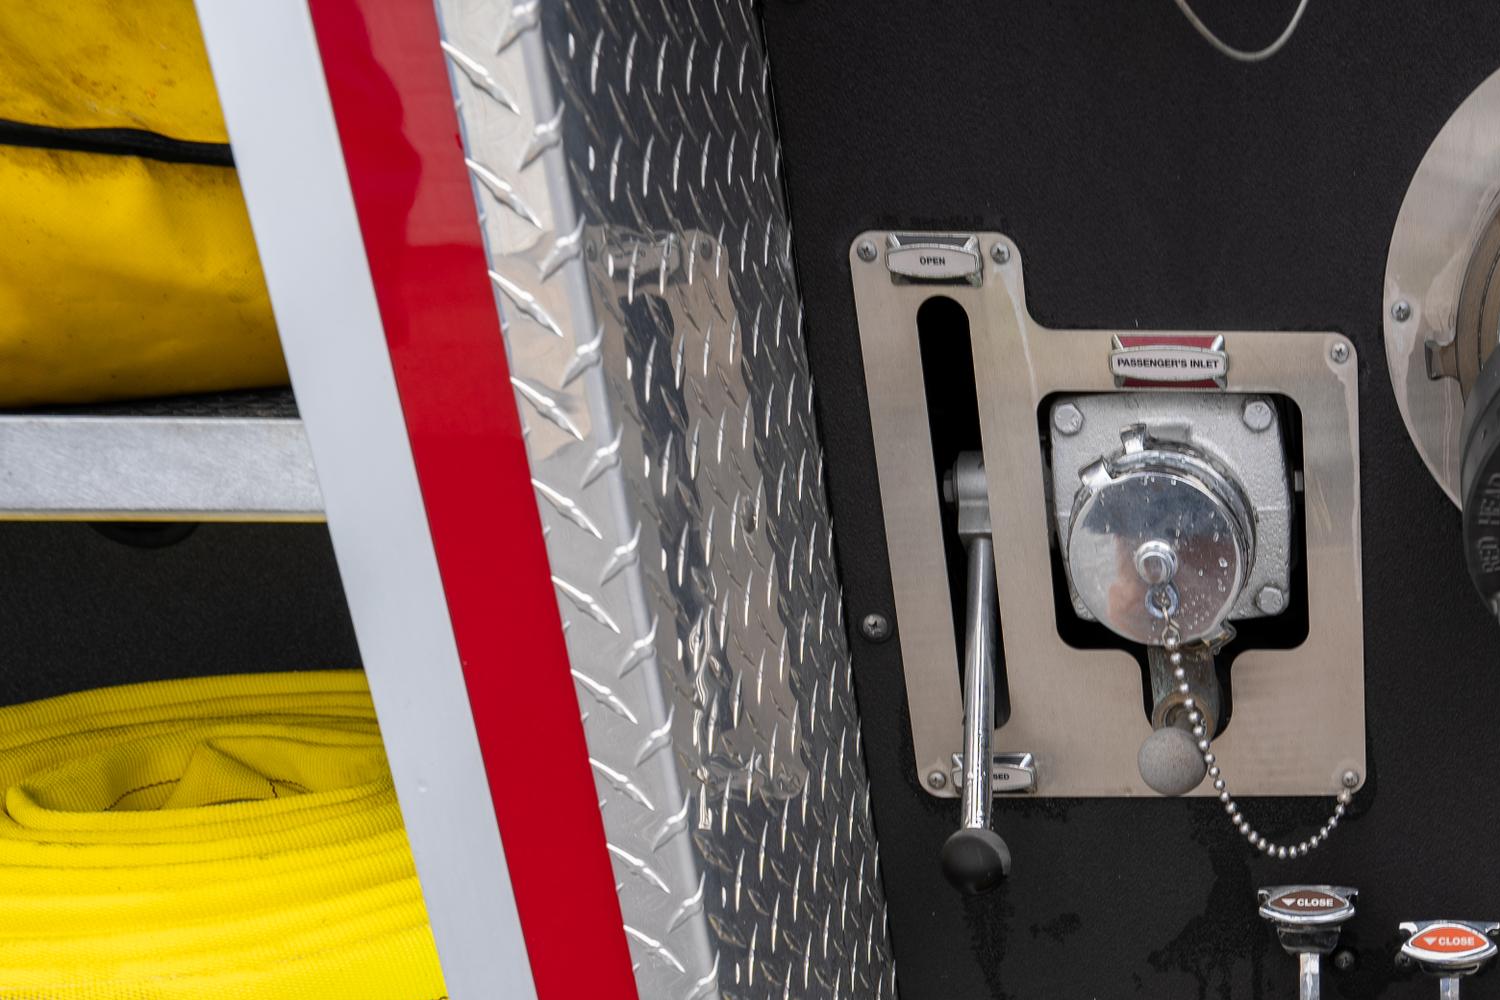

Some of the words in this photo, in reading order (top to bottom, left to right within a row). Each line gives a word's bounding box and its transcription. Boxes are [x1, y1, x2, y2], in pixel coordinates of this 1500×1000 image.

[919, 255, 946, 266] OPEN
[1117, 358, 1187, 369] PASSENGER'S
[1190, 359, 1219, 369] INLET
[1296, 897, 1334, 907] CLOSE
[1438, 936, 1475, 946] CLOSE
